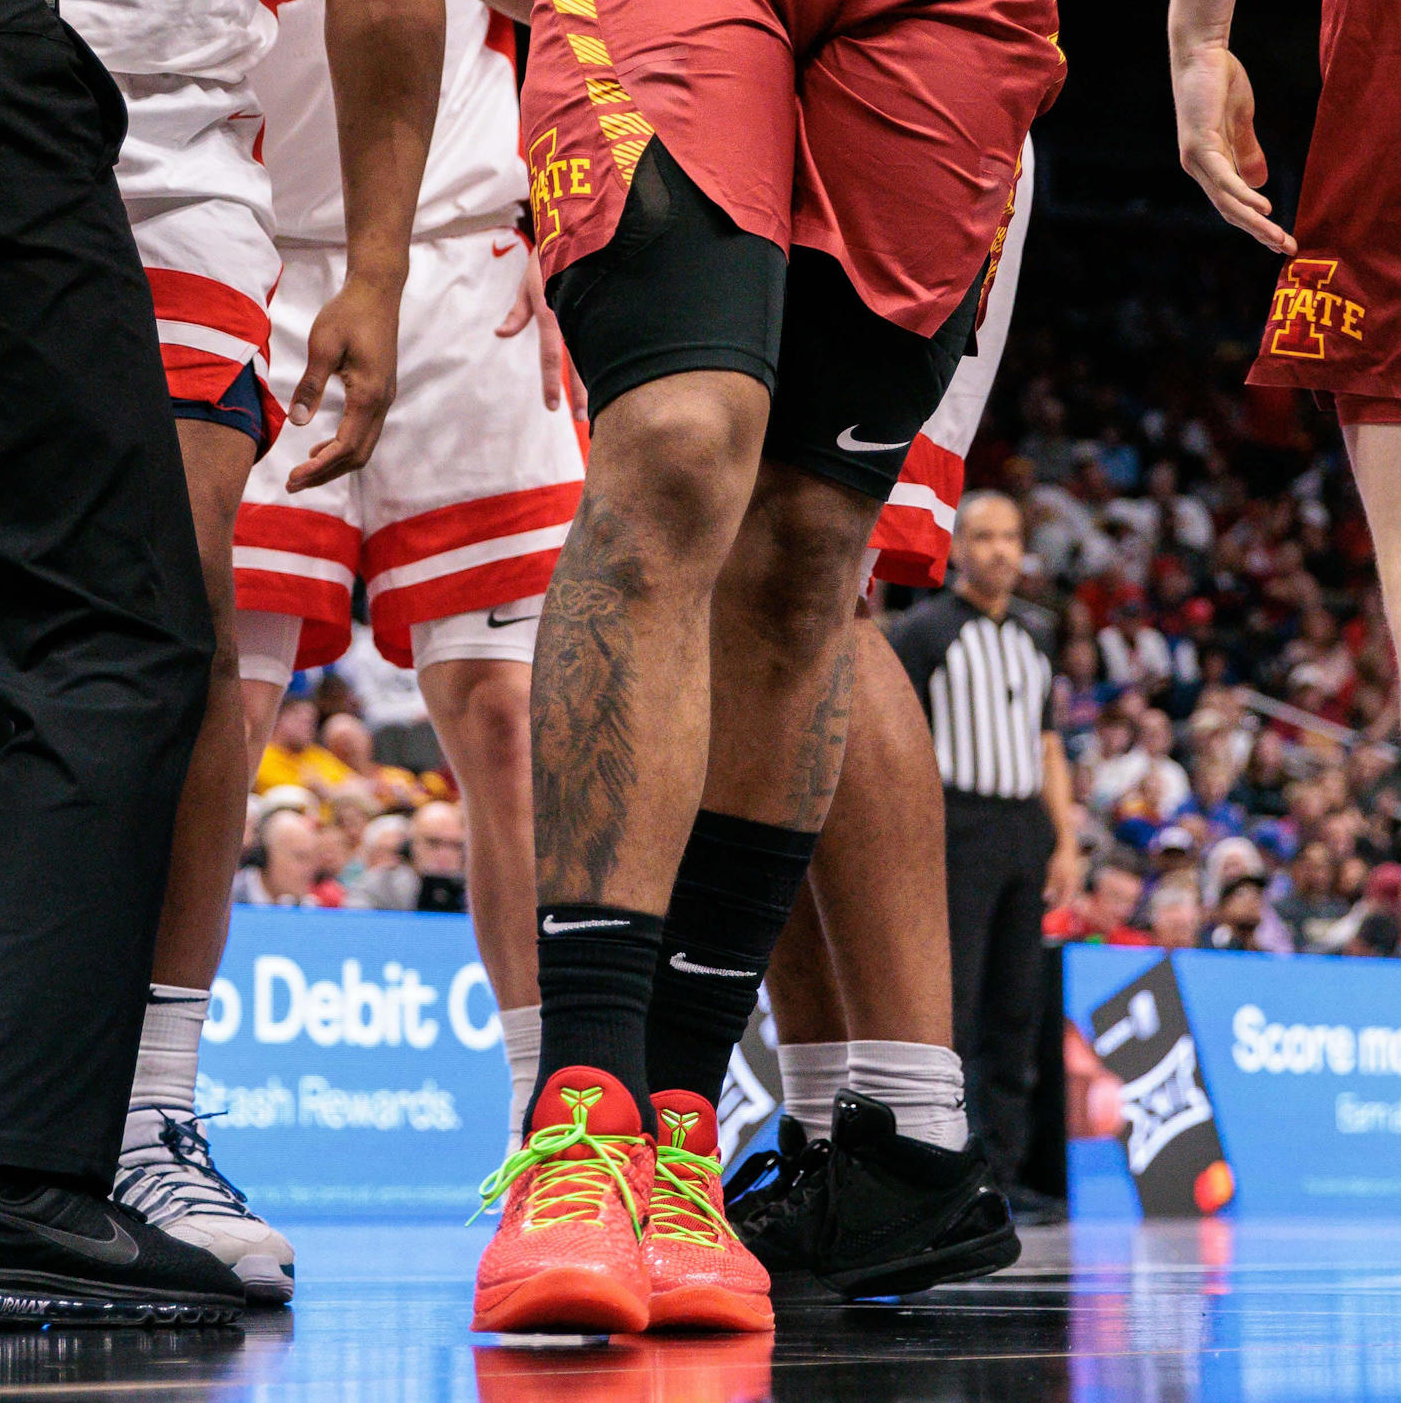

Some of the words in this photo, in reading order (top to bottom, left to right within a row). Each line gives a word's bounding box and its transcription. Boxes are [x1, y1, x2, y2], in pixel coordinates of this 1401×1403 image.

[1270, 286, 1366, 341] TATE
[253, 955, 439, 1050] Debit
[1233, 1005, 1354, 1074] Score
